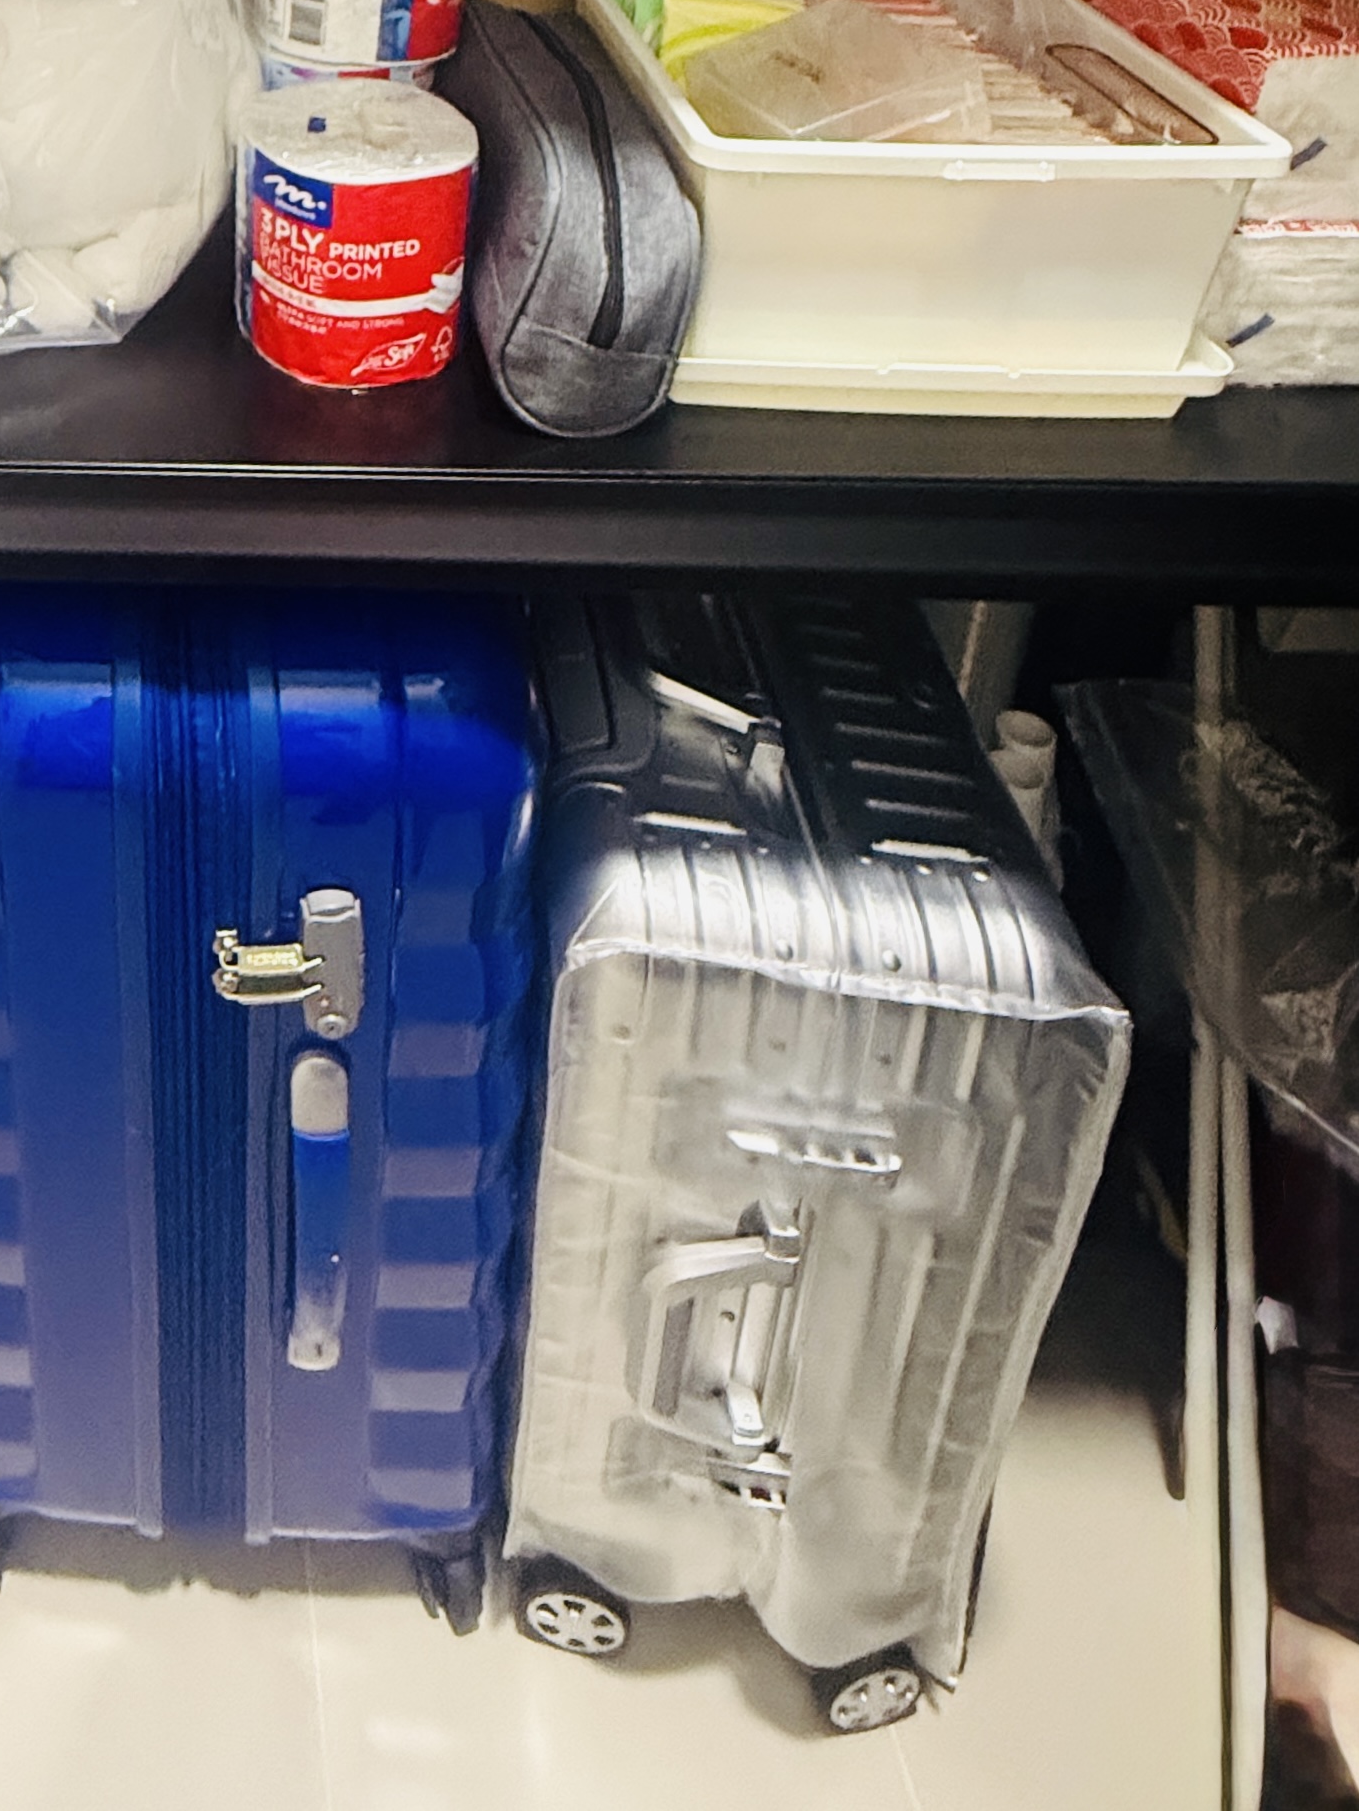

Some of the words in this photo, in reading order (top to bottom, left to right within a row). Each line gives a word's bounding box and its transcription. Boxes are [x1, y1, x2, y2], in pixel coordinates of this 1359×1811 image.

[259, 208, 275, 234] 3
[275, 217, 324, 255] PLY
[329, 239, 421, 261] PRINTED
[259, 233, 383, 280] BATHROOM
[260, 250, 324, 294] TISSUE
